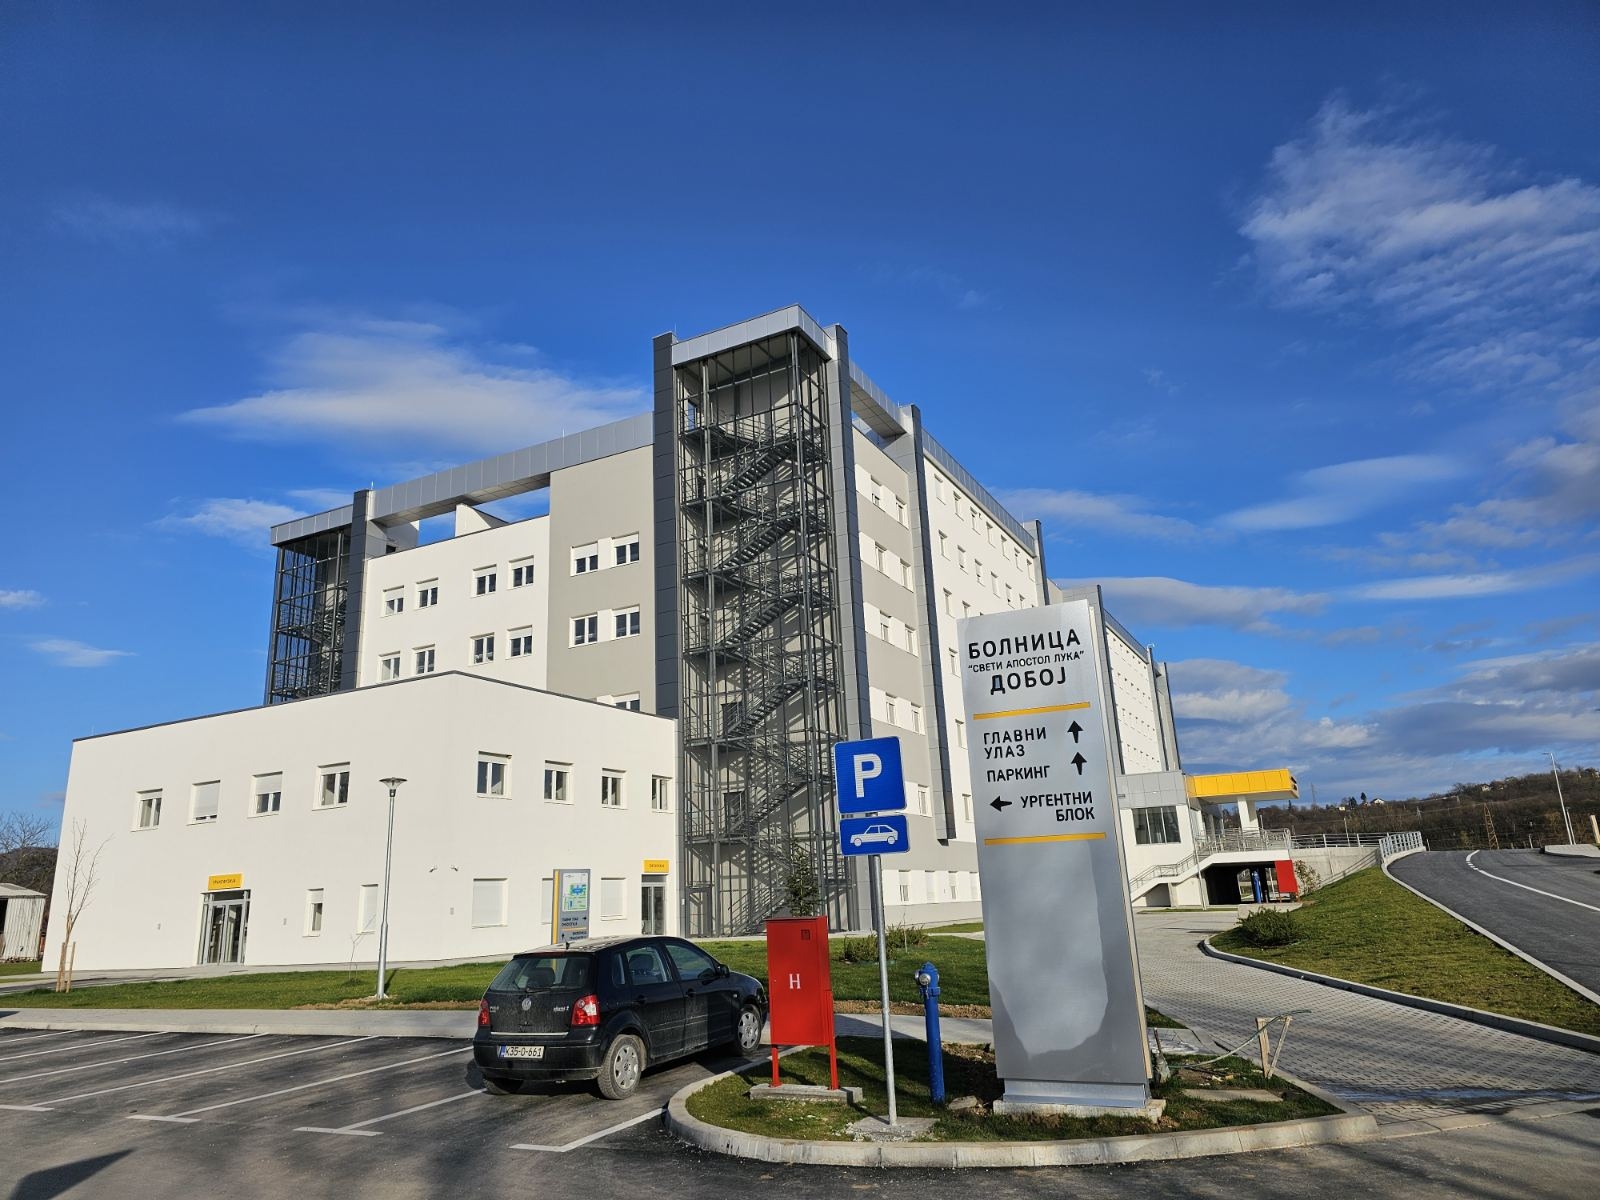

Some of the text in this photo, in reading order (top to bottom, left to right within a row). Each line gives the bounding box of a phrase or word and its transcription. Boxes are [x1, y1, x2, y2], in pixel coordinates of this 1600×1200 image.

[968, 628, 1081, 660] БОЛНИЦА
[1006, 655, 1051, 669] АПОСТОЛ
[990, 667, 1067, 695] ДОБОЈ
[983, 727, 1047, 745] ГЛАВНИ
[984, 745, 1025, 760] УЛАЗ
[853, 753, 883, 798] P
[987, 766, 1051, 783] ПАРКИНГ
[1020, 791, 1093, 809] УРГЕНТНИ
[1055, 806, 1096, 822] БЛОК
[789, 973, 801, 990] H
